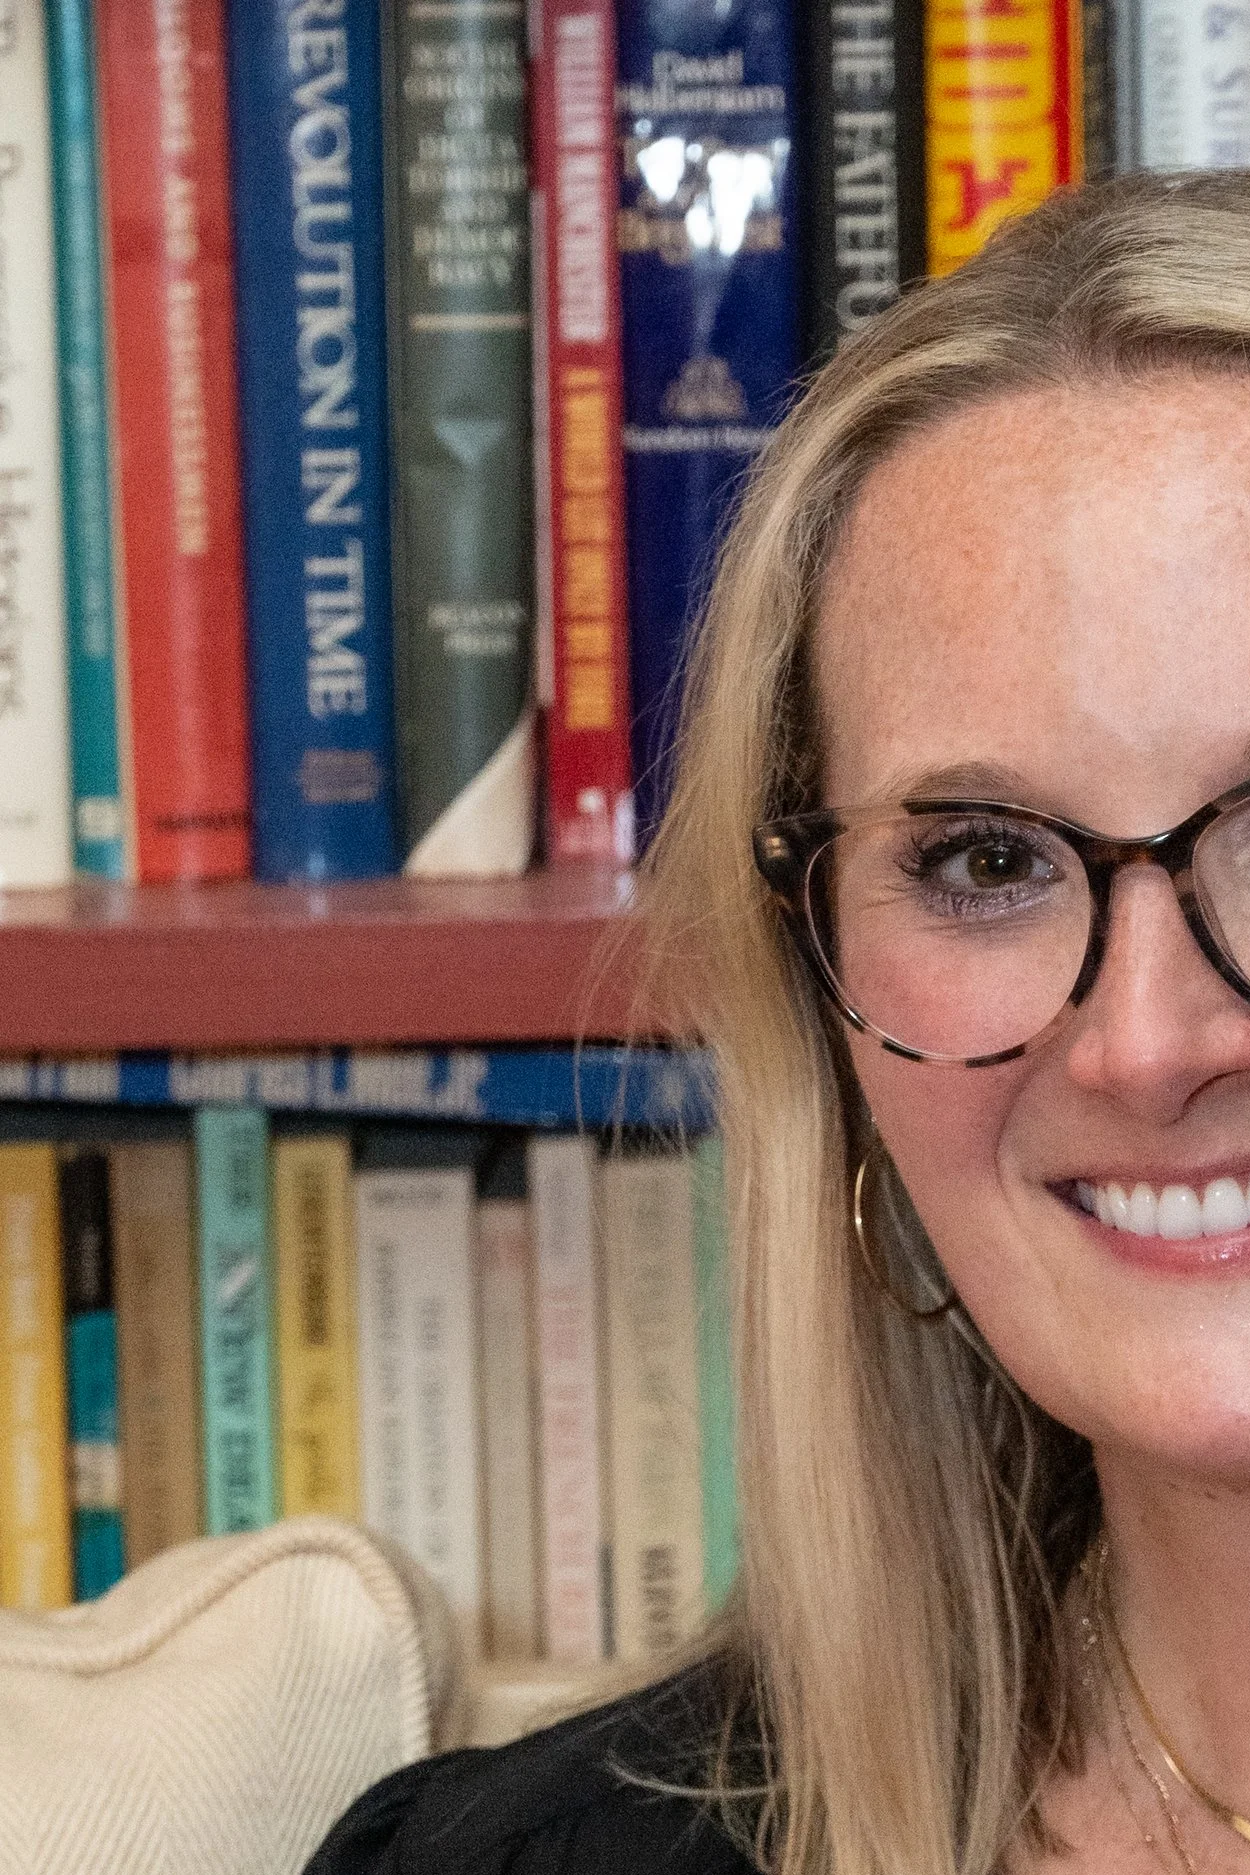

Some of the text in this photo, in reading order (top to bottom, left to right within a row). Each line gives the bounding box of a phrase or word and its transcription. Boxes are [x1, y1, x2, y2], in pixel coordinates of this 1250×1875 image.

[286, 0, 359, 430] REVOLUTION
[302, 447, 361, 528] IN
[304, 541, 369, 719] TIME
